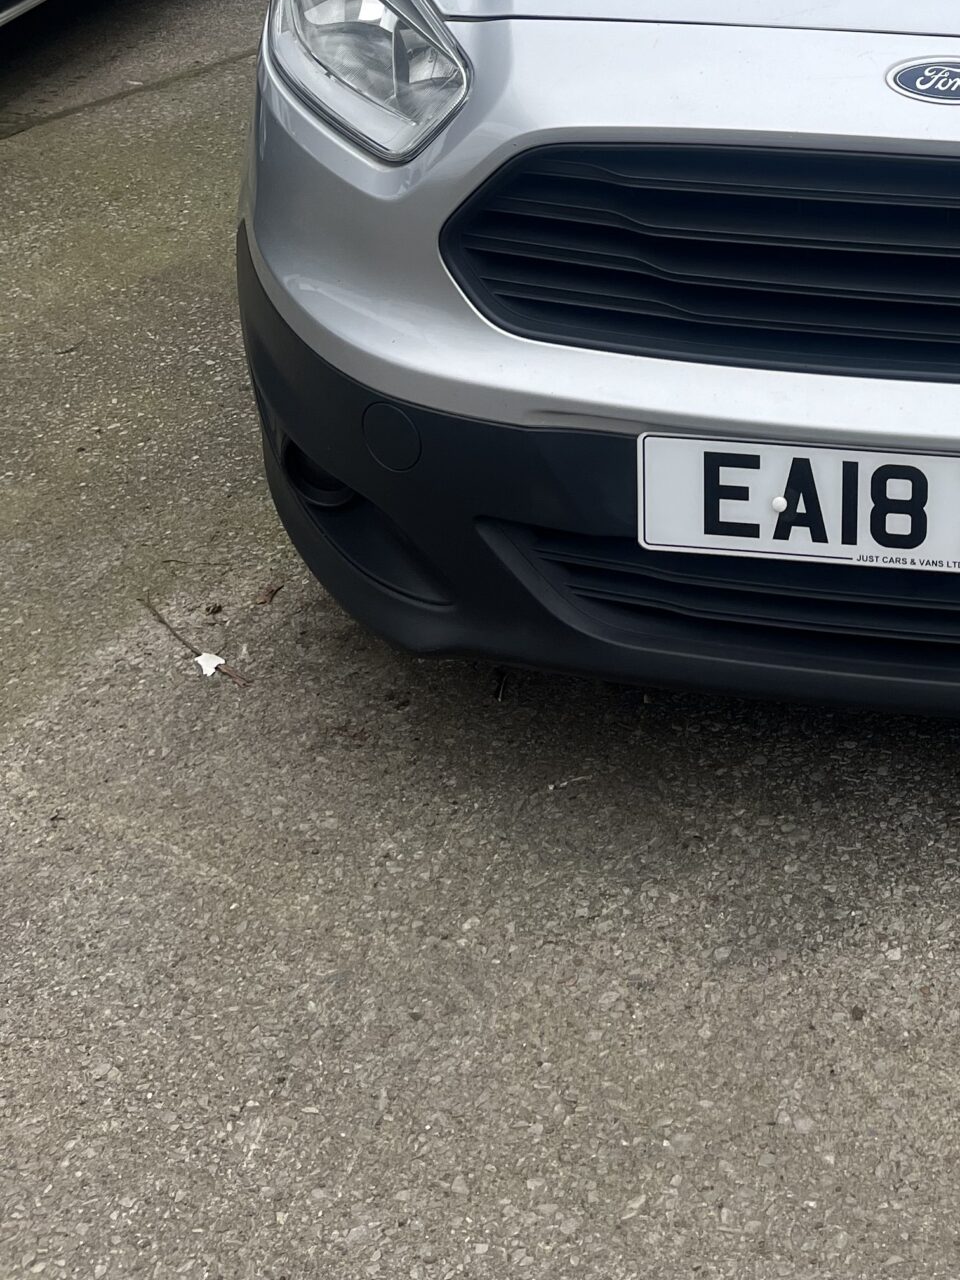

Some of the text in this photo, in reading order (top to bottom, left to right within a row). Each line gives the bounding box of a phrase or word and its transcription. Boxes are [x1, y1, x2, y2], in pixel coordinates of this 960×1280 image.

[703, 450, 929, 550] EA18
[856, 555, 879, 563] JUST
[882, 556, 907, 565] CARS
[919, 559, 944, 567] VANS
